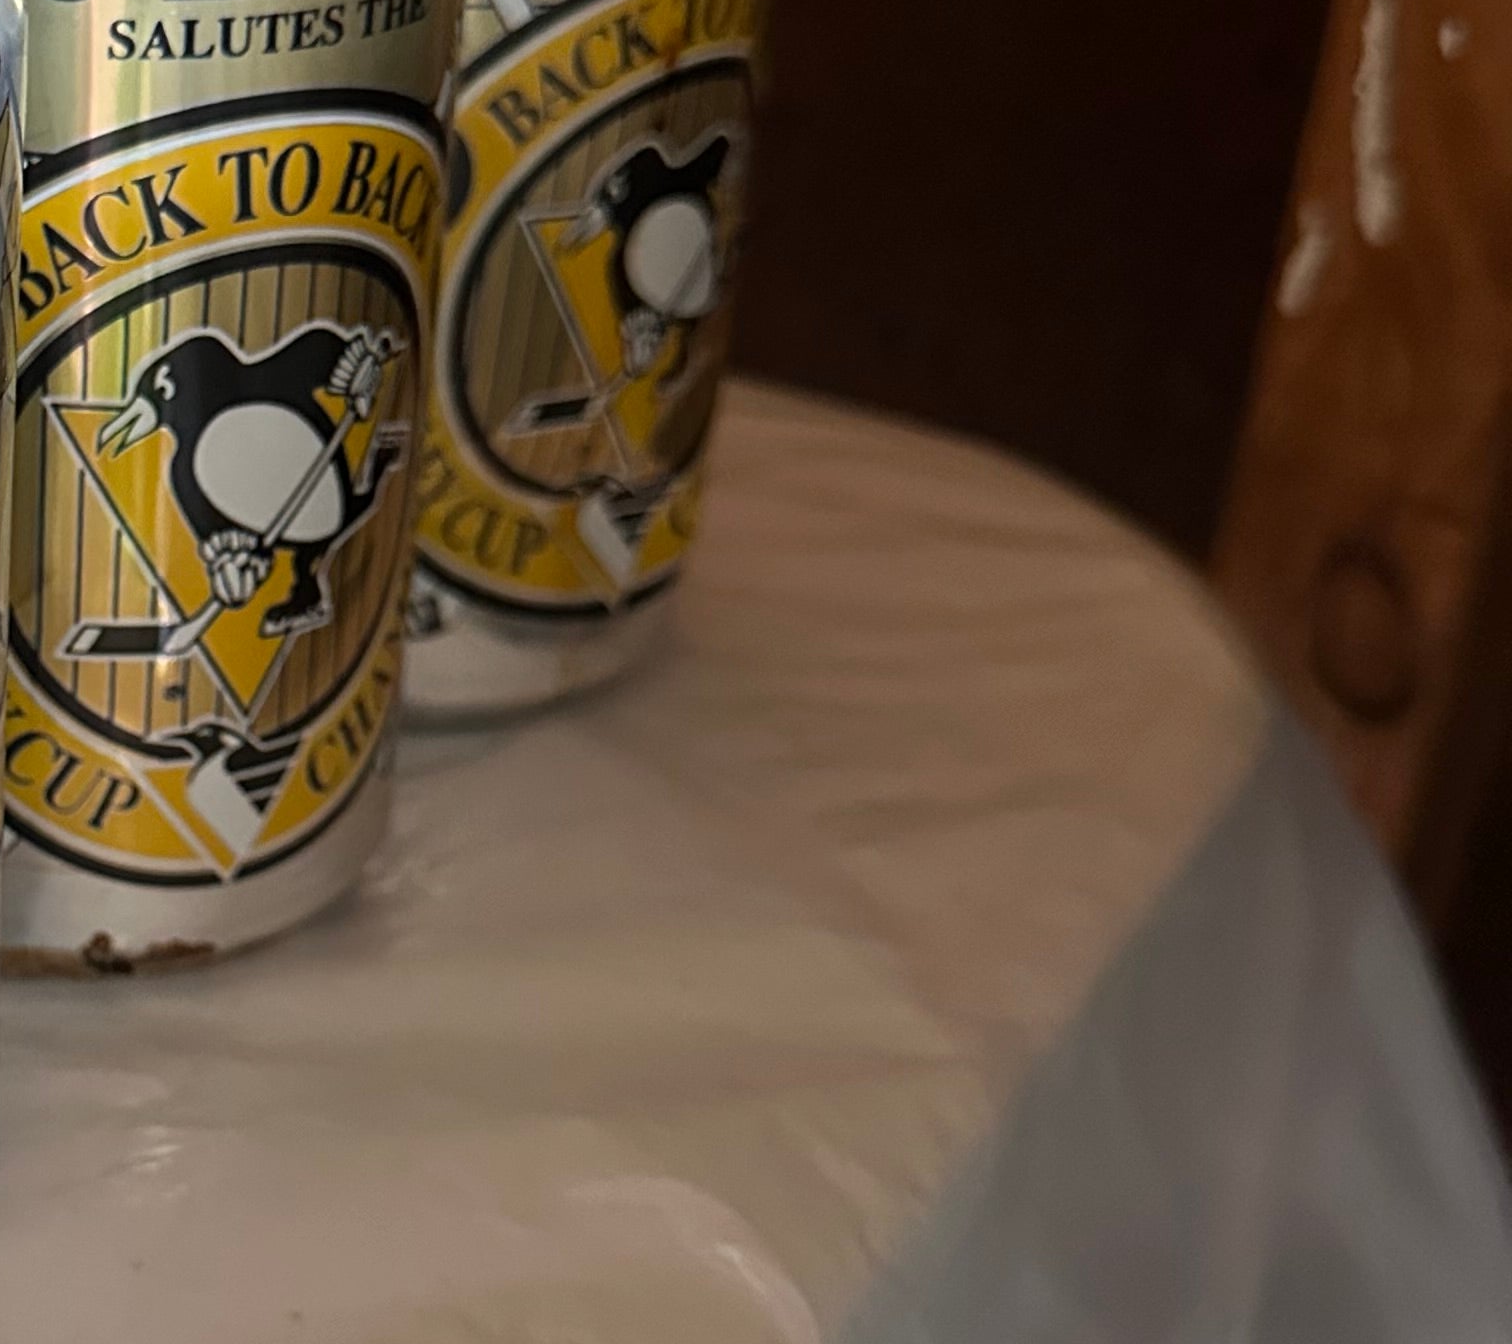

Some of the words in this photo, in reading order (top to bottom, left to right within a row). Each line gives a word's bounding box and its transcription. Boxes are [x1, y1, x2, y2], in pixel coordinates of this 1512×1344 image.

[106, 1, 347, 62] SALUTES
[18, 162, 207, 322] BACK
[217, 140, 322, 223] TO
[3, 729, 143, 831] CUP
